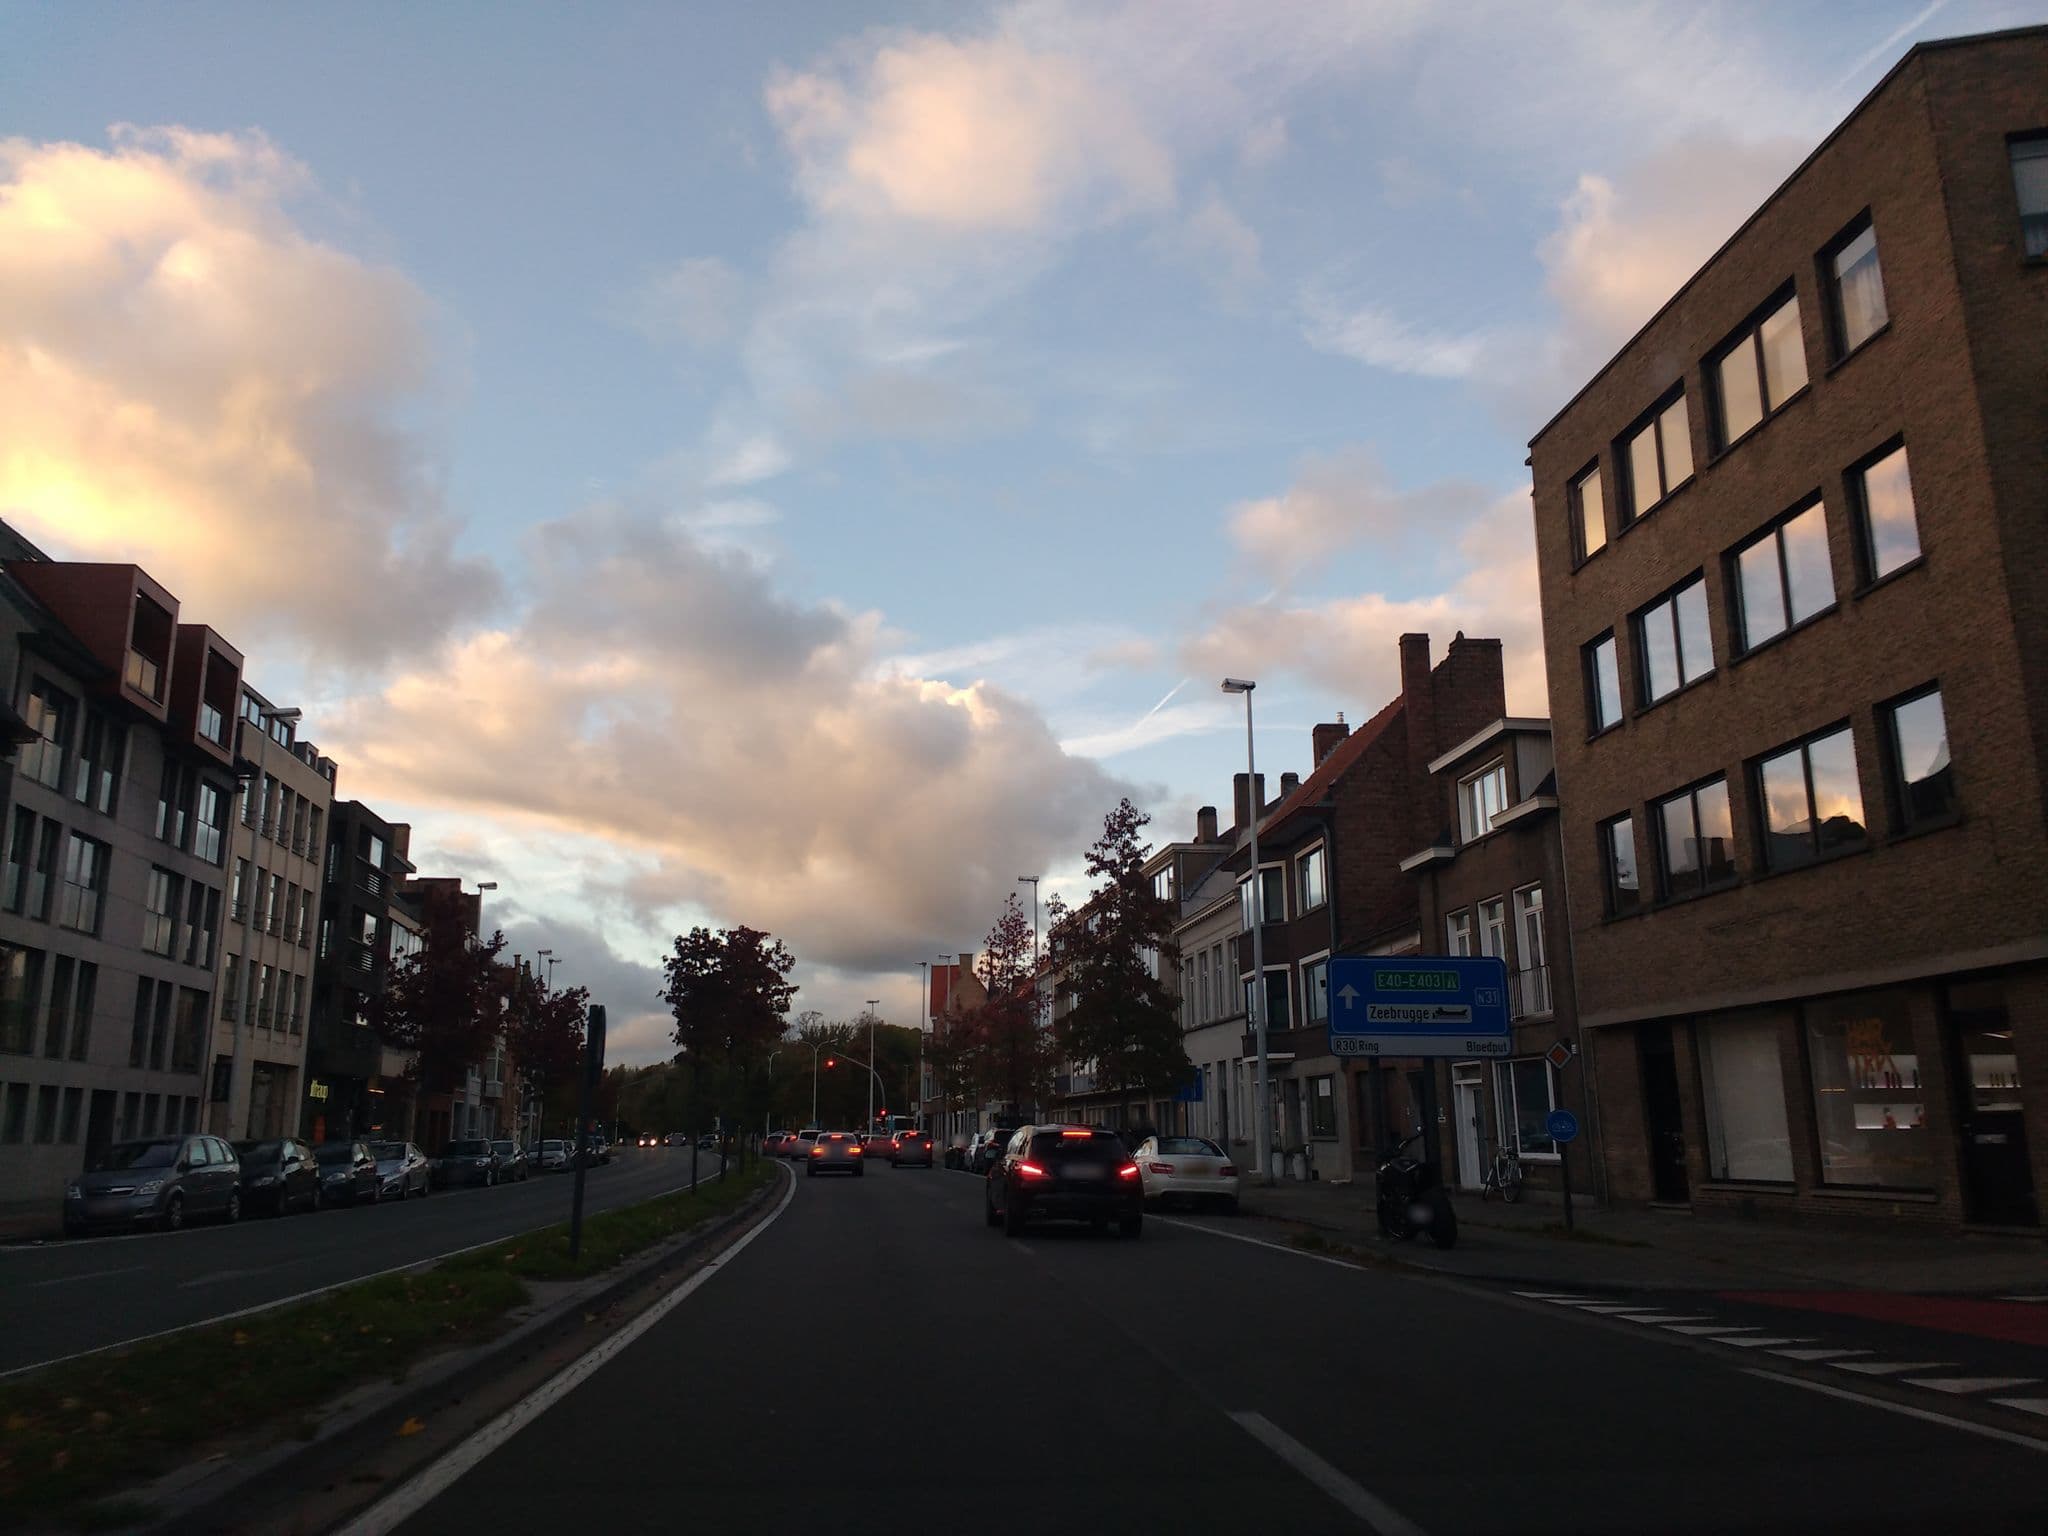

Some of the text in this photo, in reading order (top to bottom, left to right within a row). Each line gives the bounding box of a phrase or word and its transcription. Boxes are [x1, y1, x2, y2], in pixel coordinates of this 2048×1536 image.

[1377, 974, 1441, 988] E40-E403
[1370, 1006, 1430, 1022] Zeebrugge
[1336, 1040, 1379, 1054] R30 Ring
[1466, 1041, 1508, 1056] Bloedput
